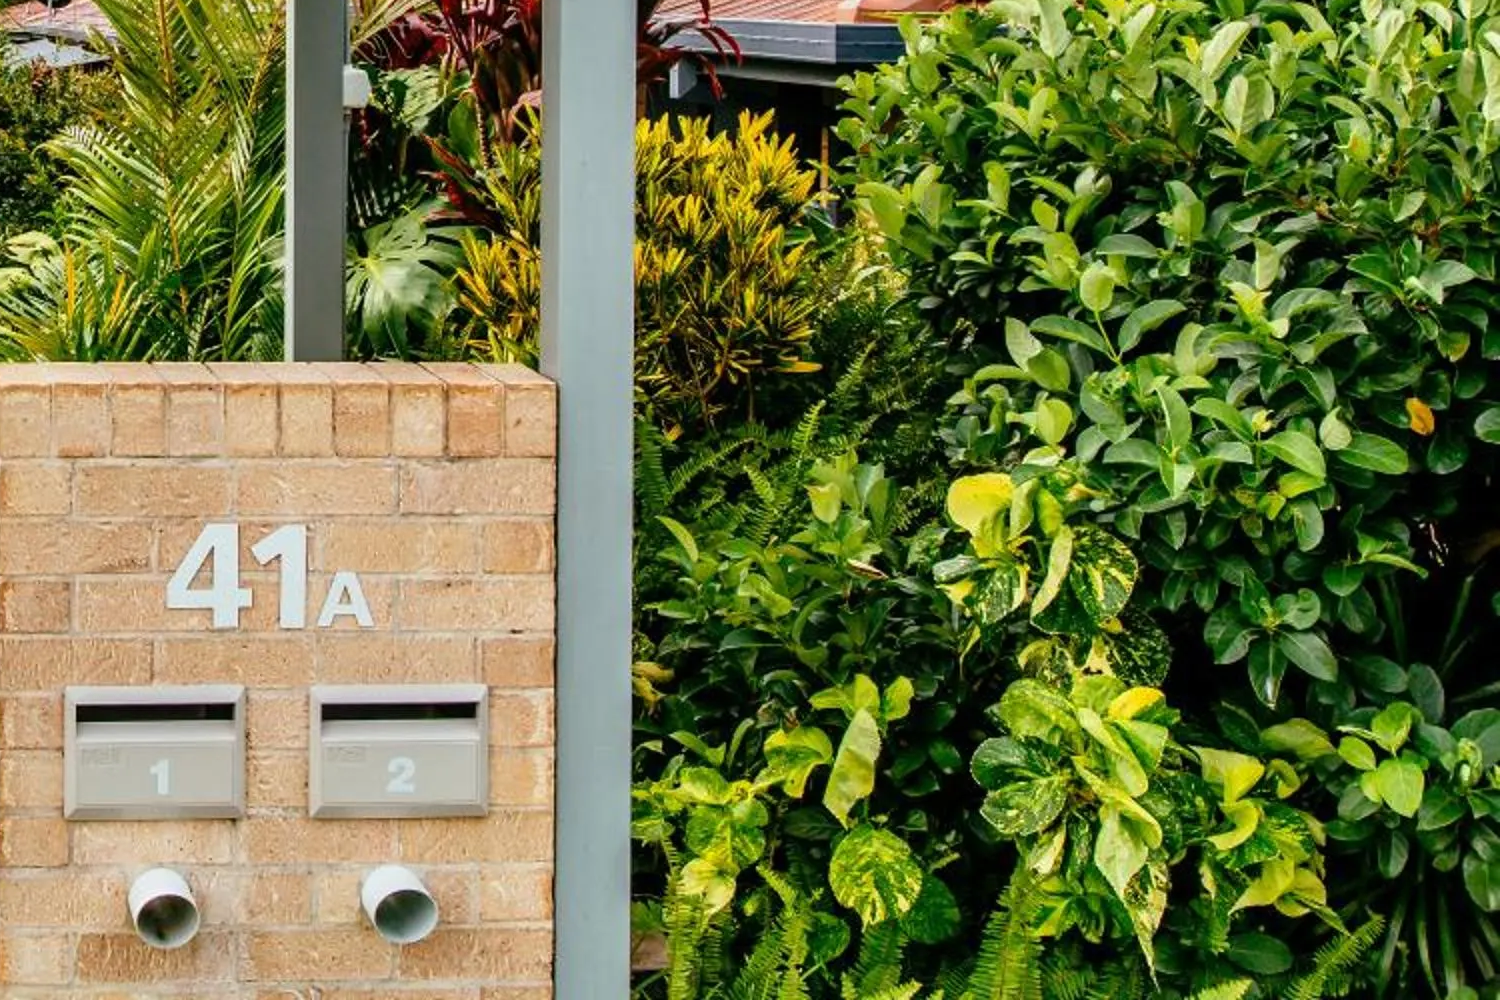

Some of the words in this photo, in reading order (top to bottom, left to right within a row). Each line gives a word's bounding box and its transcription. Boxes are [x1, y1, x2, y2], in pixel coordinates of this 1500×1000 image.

[166, 523, 375, 629] 41A
[150, 759, 171, 795] 1
[386, 757, 415, 793] 2
